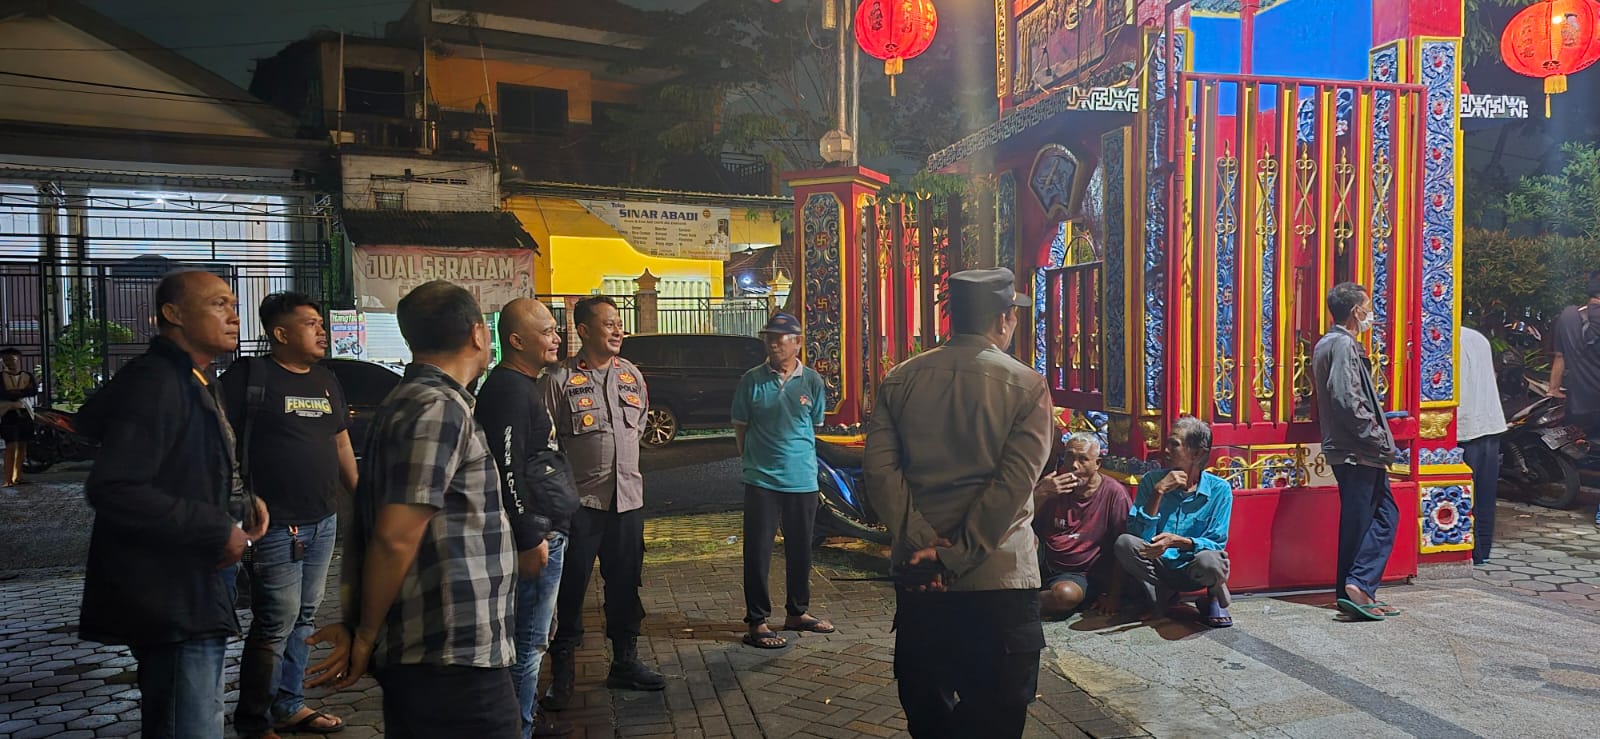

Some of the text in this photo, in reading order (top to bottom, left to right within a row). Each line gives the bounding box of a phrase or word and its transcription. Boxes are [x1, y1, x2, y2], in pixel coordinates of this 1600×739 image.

[619, 209, 698, 221] SINAR ABADI
[365, 255, 515, 281] JUAL SERAGAM
[568, 386, 595, 397] HERRY
[287, 398, 330, 413] FENCING
[506, 471, 524, 515] POLICE
